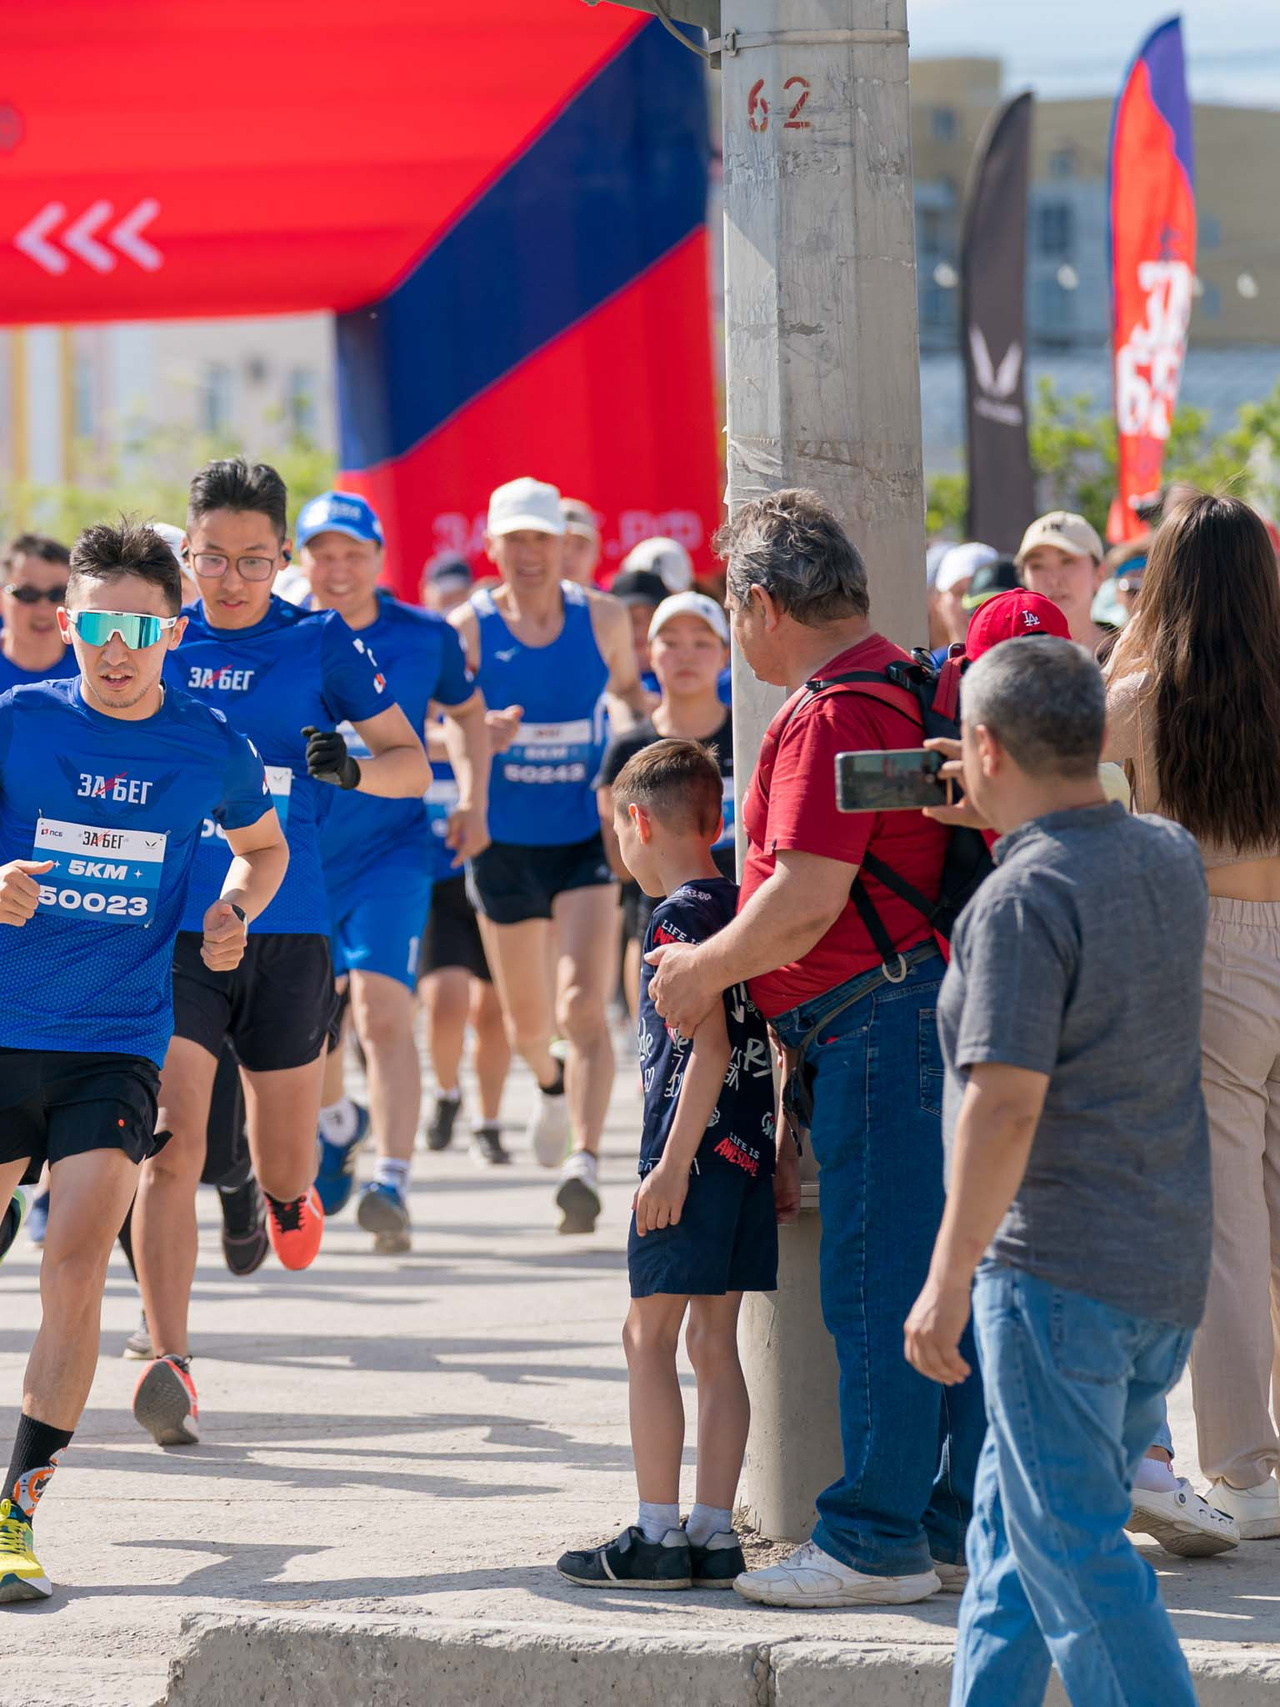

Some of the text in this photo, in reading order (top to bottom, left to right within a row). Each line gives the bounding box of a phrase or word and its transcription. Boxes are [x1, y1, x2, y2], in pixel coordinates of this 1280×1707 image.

[748, 76, 811, 133] 62
[1022, 610, 1040, 627] LA
[188, 667, 254, 691] ЗА БЕГ
[77, 773, 153, 805] ЗА БЕГ
[82, 830, 99, 847] ЗА
[102, 833, 124, 850] БЕГ
[67, 859, 129, 880] 5KM
[38, 884, 148, 917] 50023
[729, 1132, 747, 1152] LIFE
